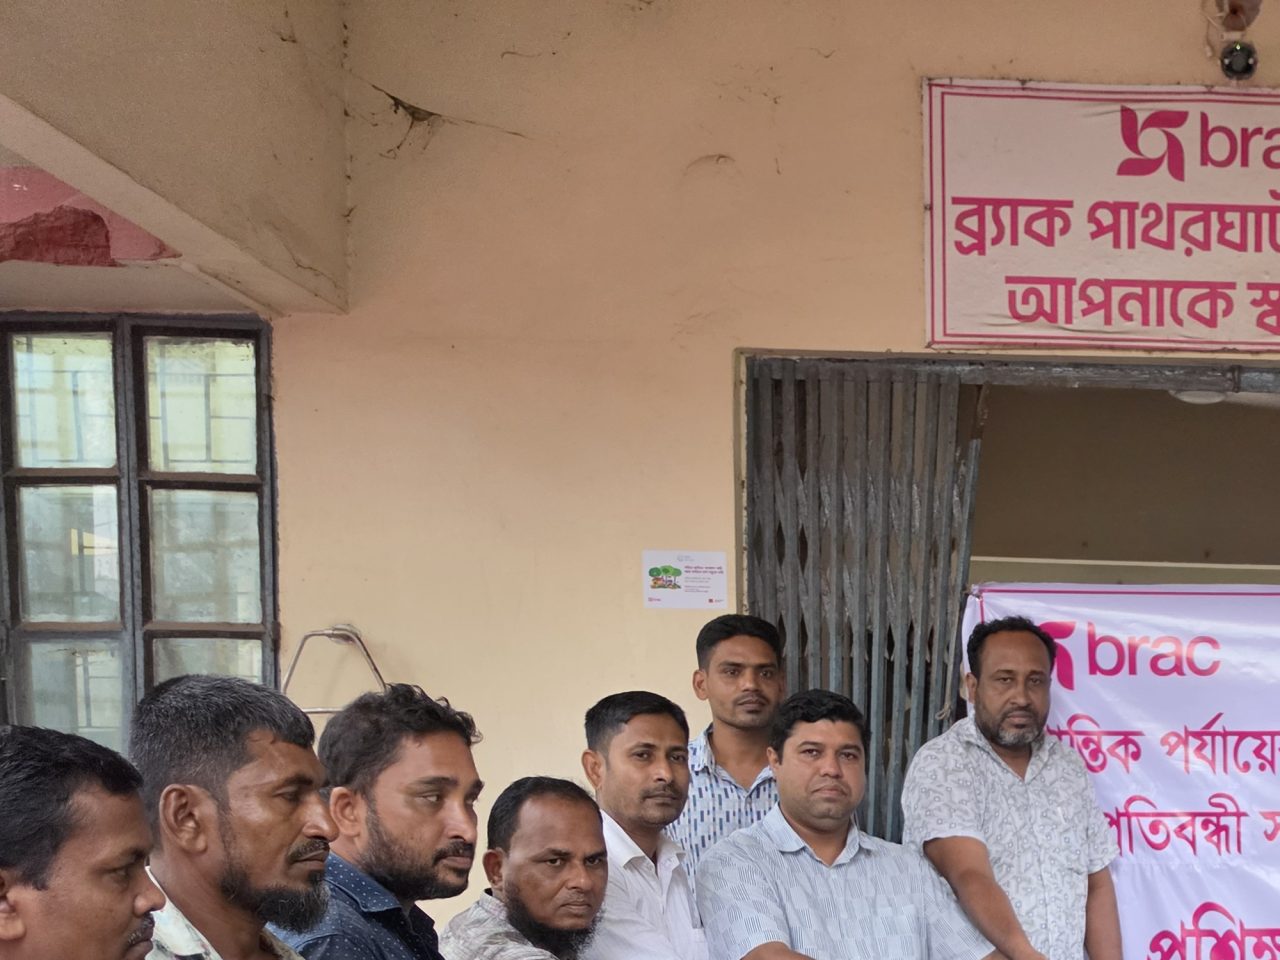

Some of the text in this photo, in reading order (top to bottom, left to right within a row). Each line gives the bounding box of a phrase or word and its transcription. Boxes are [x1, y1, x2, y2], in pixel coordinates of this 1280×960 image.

[951, 196, 1073, 257] ব্র্যাক
[1005, 276, 1236, 328] আপনাকে
[1087, 621, 1221, 677] brac
